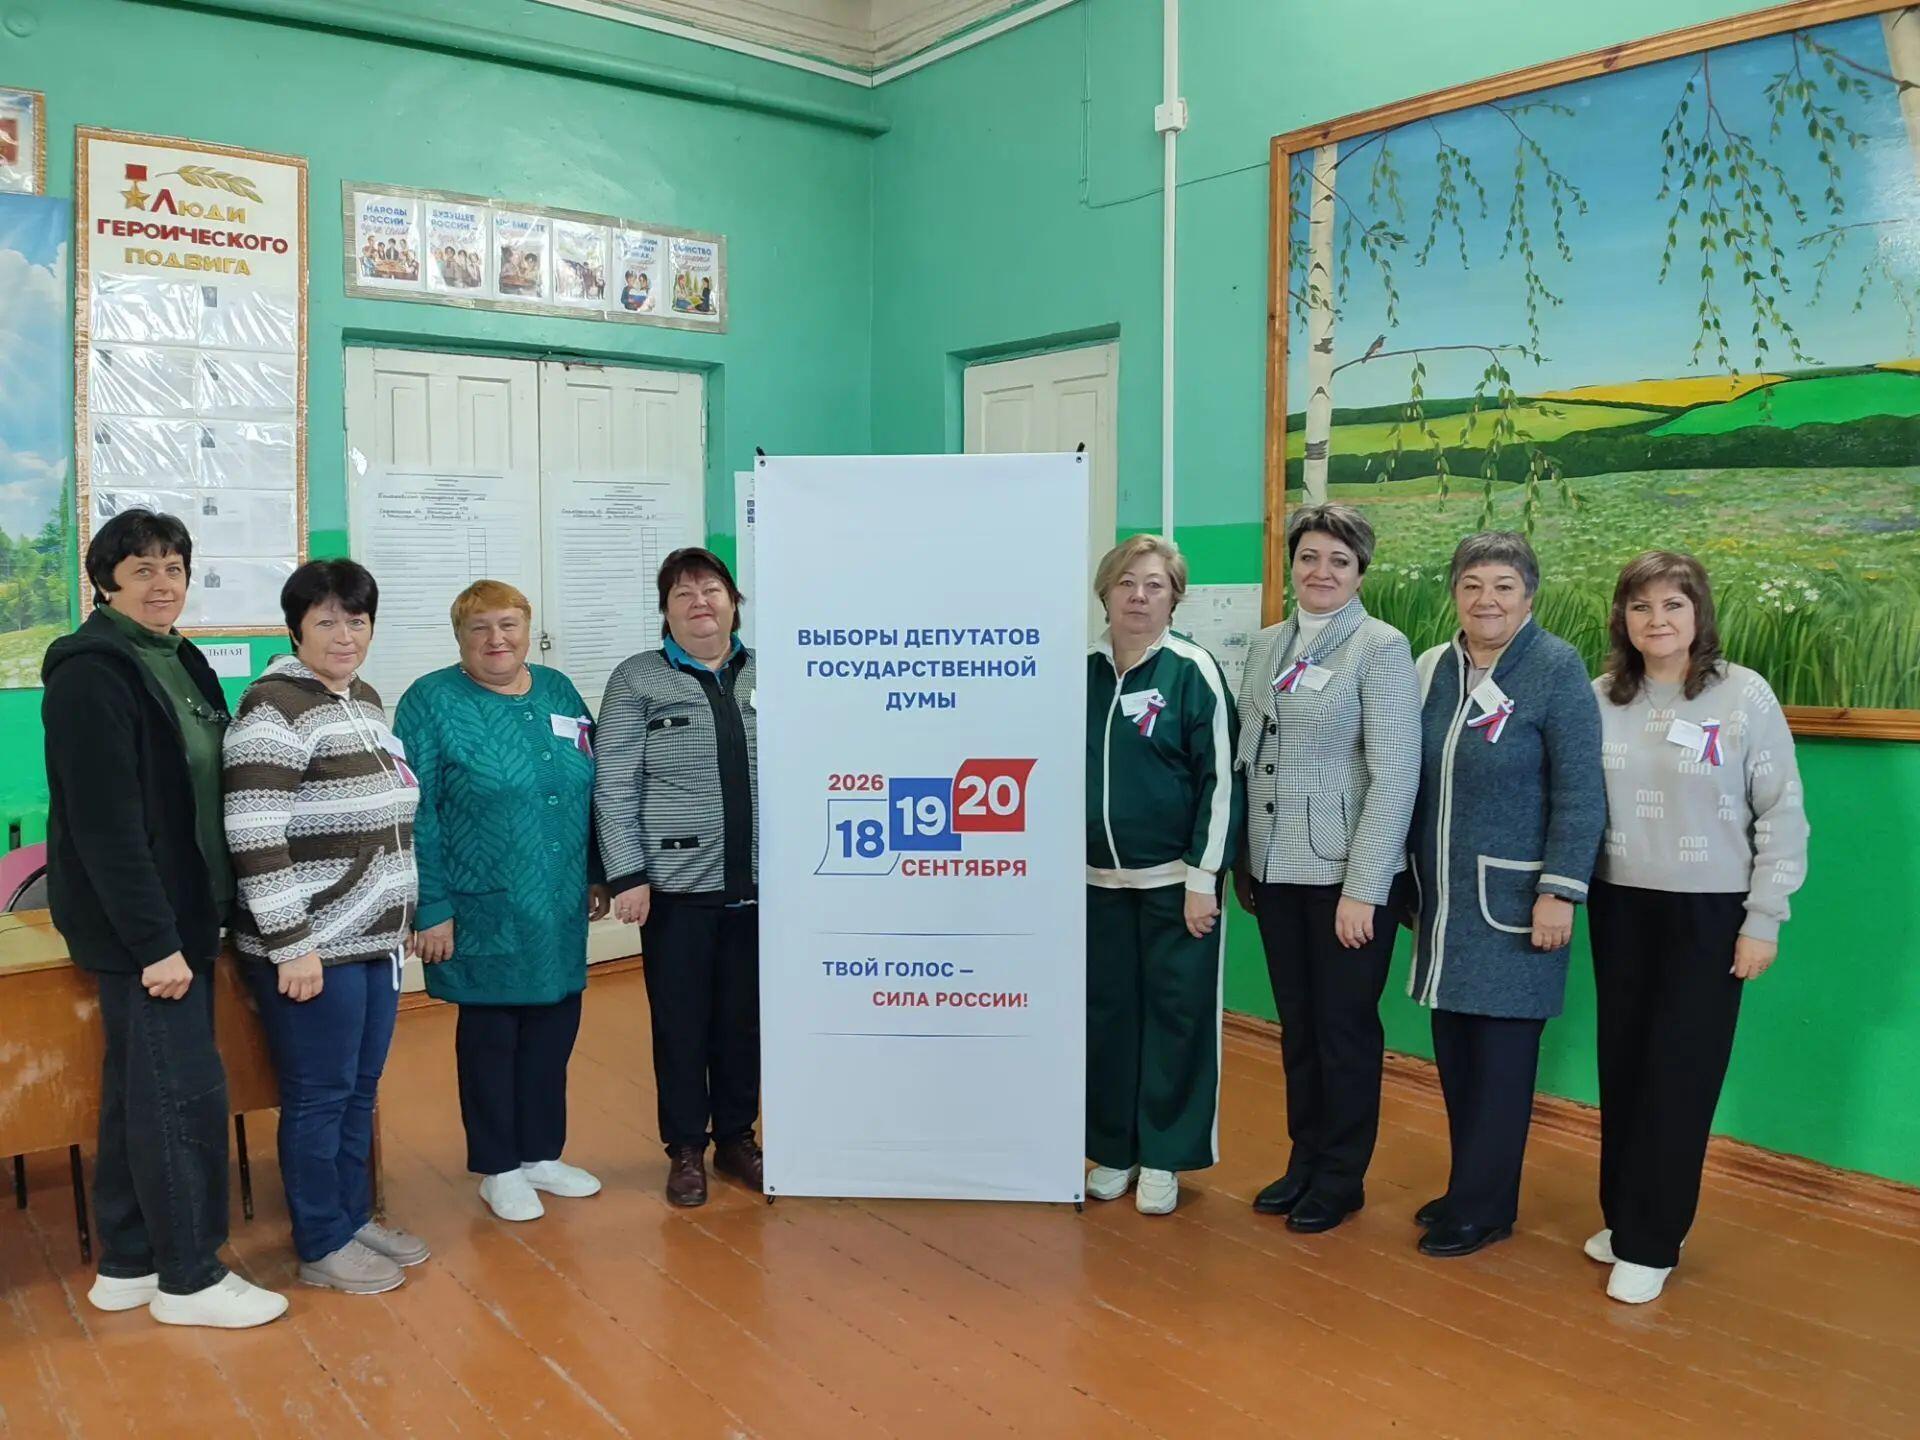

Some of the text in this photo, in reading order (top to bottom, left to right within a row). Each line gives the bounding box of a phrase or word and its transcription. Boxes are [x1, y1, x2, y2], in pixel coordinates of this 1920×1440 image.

[362, 214, 404, 226] РОССИИ
[366, 205, 408, 217] НАРОДЫ
[97, 218, 289, 255] ГЕРОИЧЕСКОГО
[124, 247, 251, 276] ПОДВИГА
[798, 628, 1040, 648] ВЫБОРЫ ДЕПУТАТОВ
[206, 648, 243, 656] ЛЬНАЯ
[806, 655, 1036, 680] ГОСУДАРСТВЕННОЙ
[885, 692, 956, 711] ДУМЫ
[828, 774, 884, 791] 2026
[958, 775, 1020, 816] 20
[896, 796, 947, 836] 19
[835, 819, 885, 858] 18
[901, 859, 1027, 877] СЕНТЯБРЯ
[822, 957, 879, 977] ТВОЙ
[884, 962, 954, 977] ГОЛОС
[873, 992, 1028, 1007] СИЛА РОССИИ!
